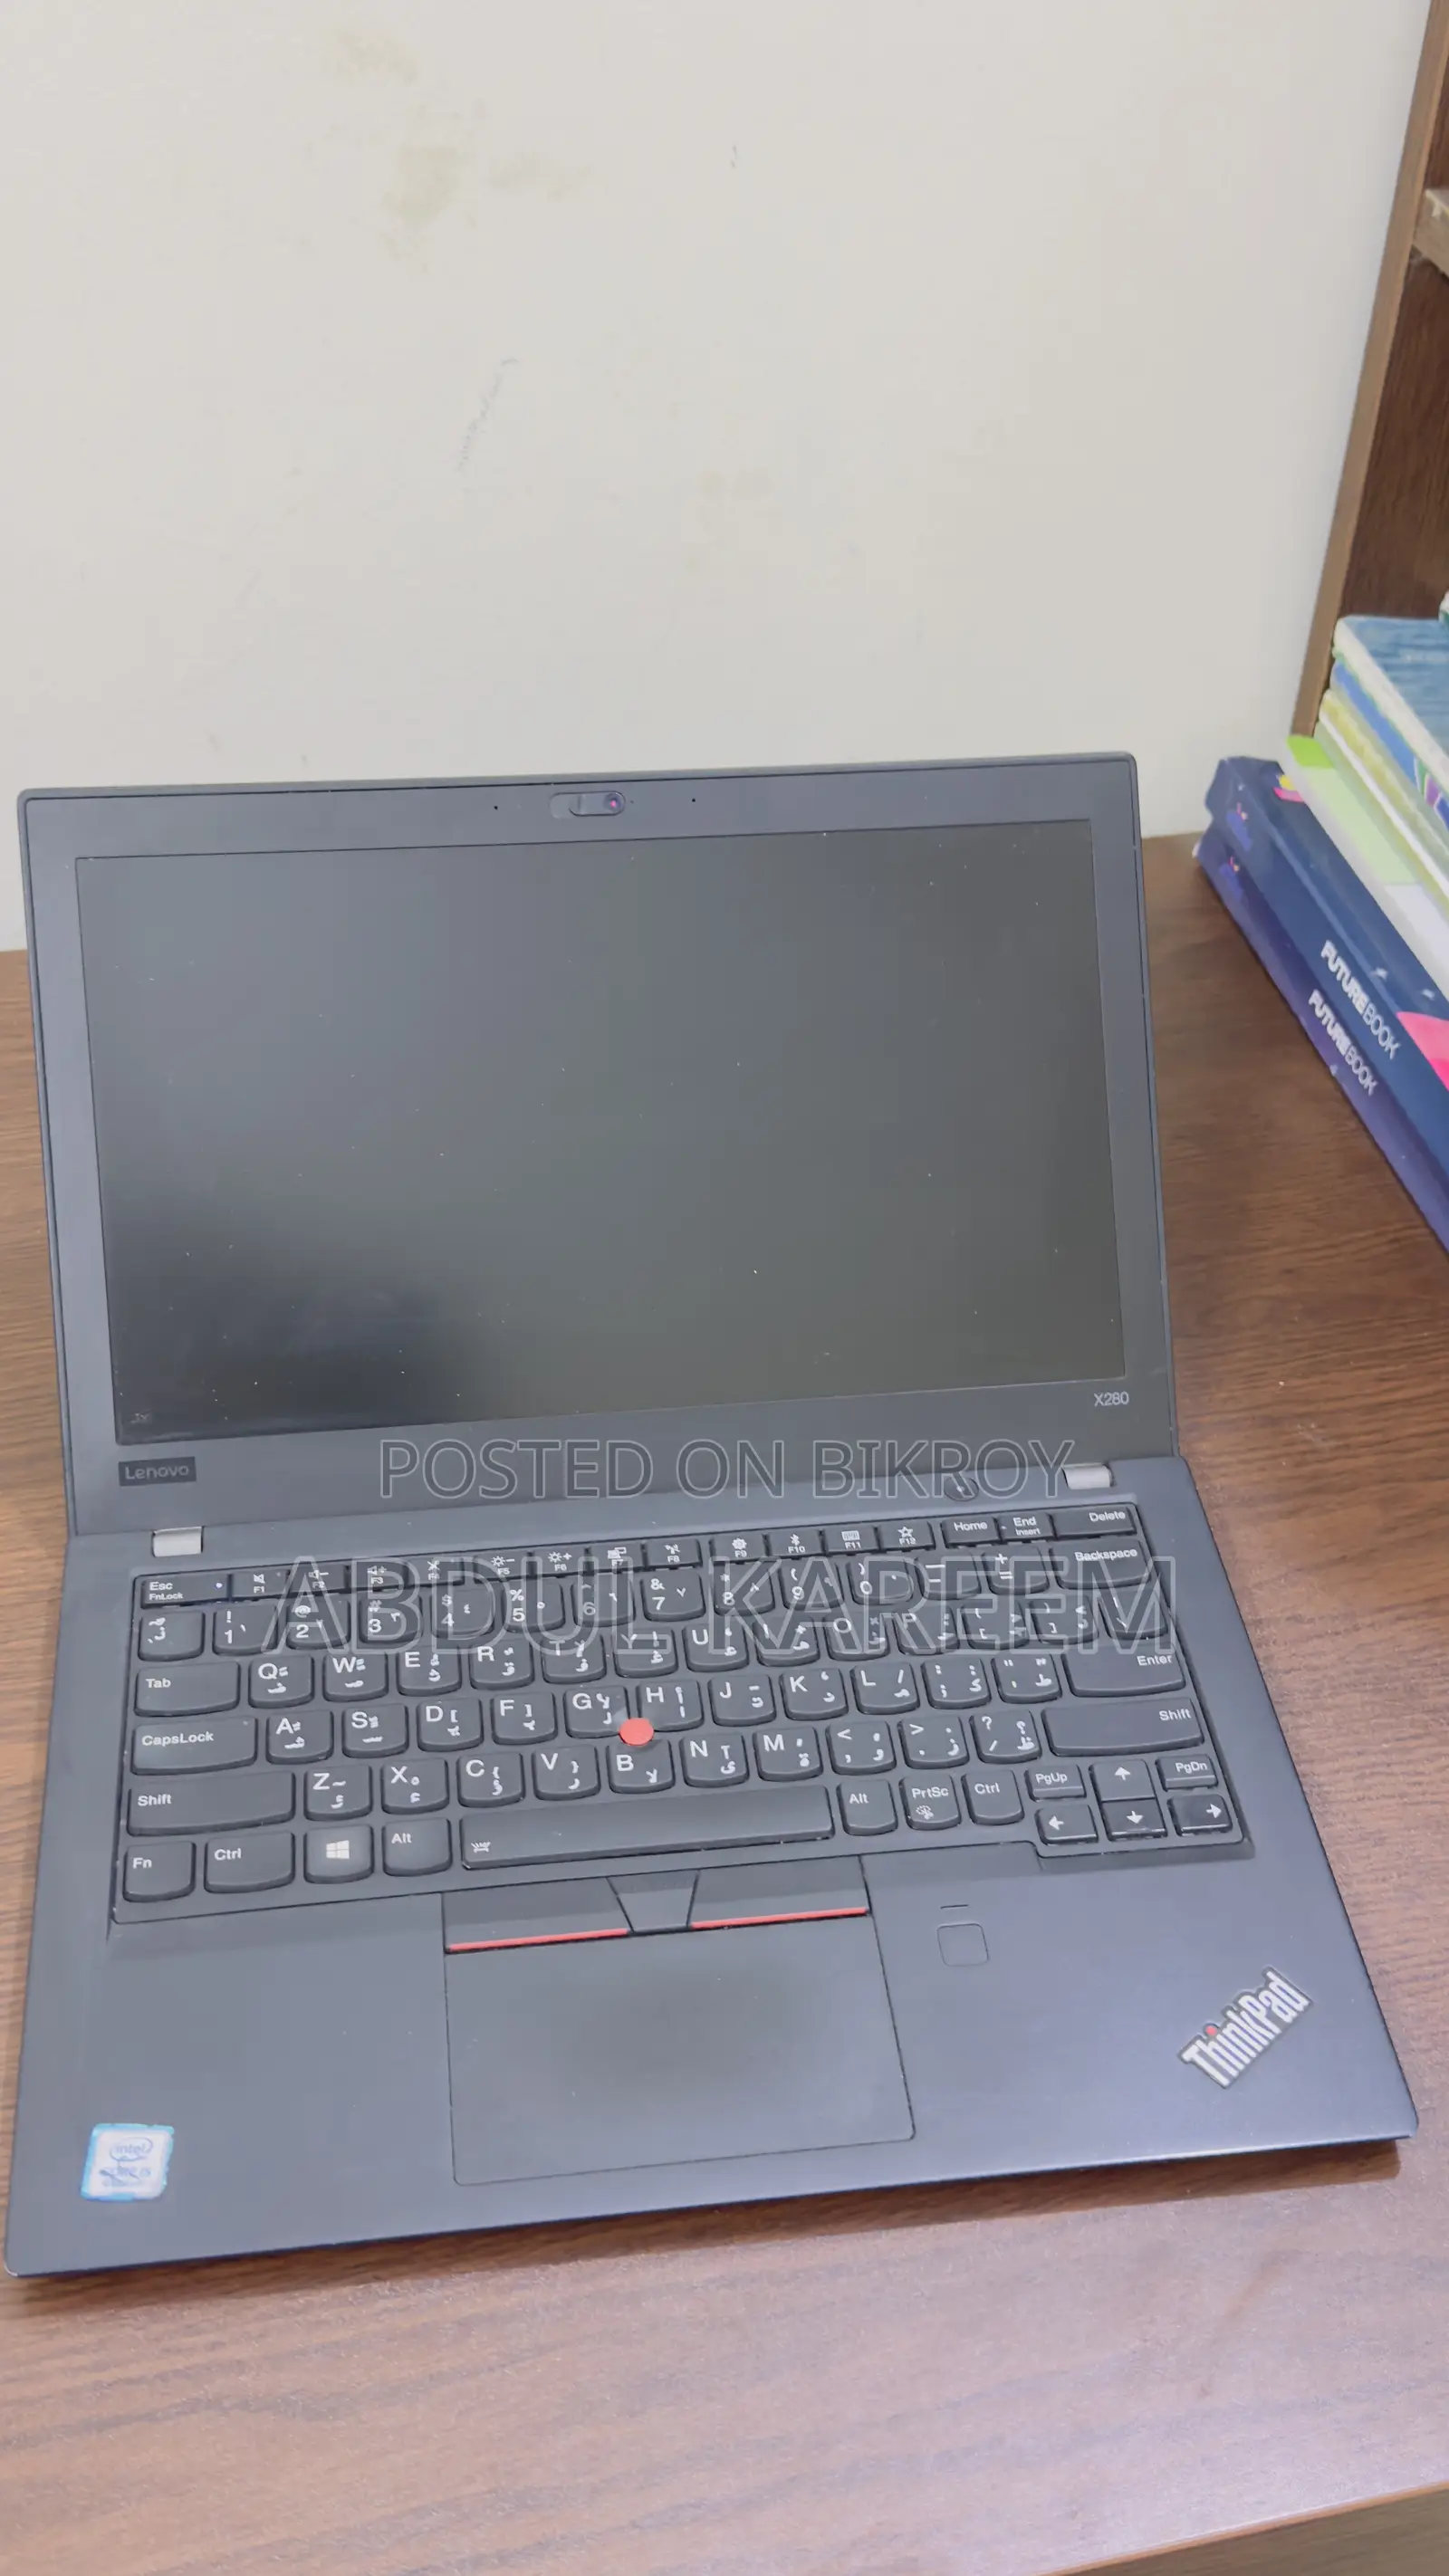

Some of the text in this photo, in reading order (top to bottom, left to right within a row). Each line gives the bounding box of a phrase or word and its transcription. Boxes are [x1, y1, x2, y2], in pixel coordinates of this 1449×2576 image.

[1094, 1391, 1130, 1406] X280
[125, 1465, 189, 1480] Lenovo
[1012, 1516, 1037, 1527] End
[1089, 1510, 1127, 1523] Delete
[954, 1520, 988, 1532] Home
[787, 1545, 806, 1554] F10
[844, 1541, 861, 1550] F11
[734, 1550, 747, 1558] F9
[1074, 1547, 1138, 1563] Backspace
[149, 1581, 174, 1592] Esc
[253, 1585, 265, 1594] F1
[792, 1585, 805, 1600] 9
[149, 1592, 184, 1601] FnLock
[651, 1596, 666, 1611] 7
[722, 1591, 735, 1606] 8
[512, 1607, 526, 1622] 5
[582, 1601, 597, 1616] 6
[368, 1618, 382, 1633] 3
[440, 1612, 456, 1627] 4
[832, 1617, 852, 1633] O
[295, 1623, 310, 1639] 2
[691, 1629, 709, 1646] U
[549, 1640, 566, 1656] T
[620, 1633, 638, 1650] Y
[404, 1652, 421, 1668] E
[476, 1646, 495, 1662] R
[1137, 1653, 1174, 1667] Enter
[257, 1662, 278, 1680] Q
[331, 1656, 357, 1673] W
[145, 1677, 172, 1689] Tab
[789, 1675, 809, 1693] K
[860, 1670, 877, 1687] L
[645, 1686, 665, 1703] H
[719, 1681, 732, 1699] J
[499, 1700, 515, 1717] F
[572, 1692, 592, 1710] G
[350, 1710, 368, 1729] S
[425, 1705, 444, 1723] D
[1158, 1708, 1192, 1721] Shift
[275, 1717, 294, 1735] A
[141, 1730, 215, 1747] CapsLock
[763, 1733, 785, 1752] M
[689, 1739, 709, 1758] N
[465, 1758, 485, 1777] C
[540, 1752, 559, 1771] V
[616, 1754, 635, 1772] B
[1175, 1761, 1209, 1774] PgDn
[312, 1772, 331, 1791] Z
[390, 1765, 408, 1785] X
[1035, 1772, 1069, 1785] PgUp
[911, 1786, 950, 1799] PrtSc
[974, 1782, 1001, 1795] Ctrl
[137, 1793, 172, 1806] Shift
[849, 1793, 869, 1805] Alt
[390, 1833, 413, 1843] Alt
[214, 1847, 243, 1861] Ctrl
[132, 1857, 153, 1869] Fn
[1180, 1970, 1310, 2087] ThinkPad
